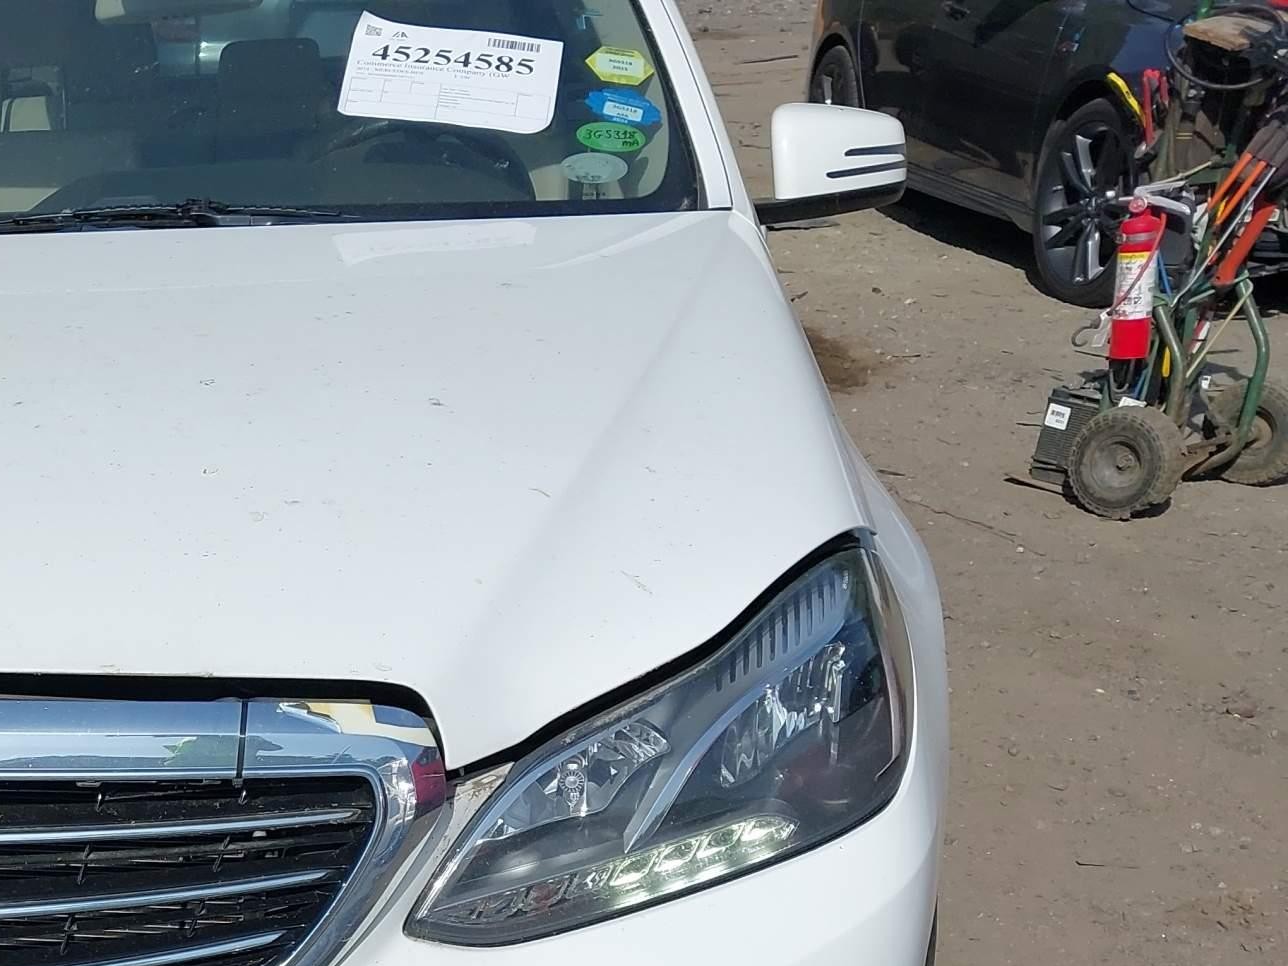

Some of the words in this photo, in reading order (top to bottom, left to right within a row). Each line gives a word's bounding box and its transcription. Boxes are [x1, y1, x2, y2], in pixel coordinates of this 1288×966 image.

[372, 44, 535, 75] 45254585
[404, 63, 444, 72] Insurance
[446, 66, 485, 77] Company
